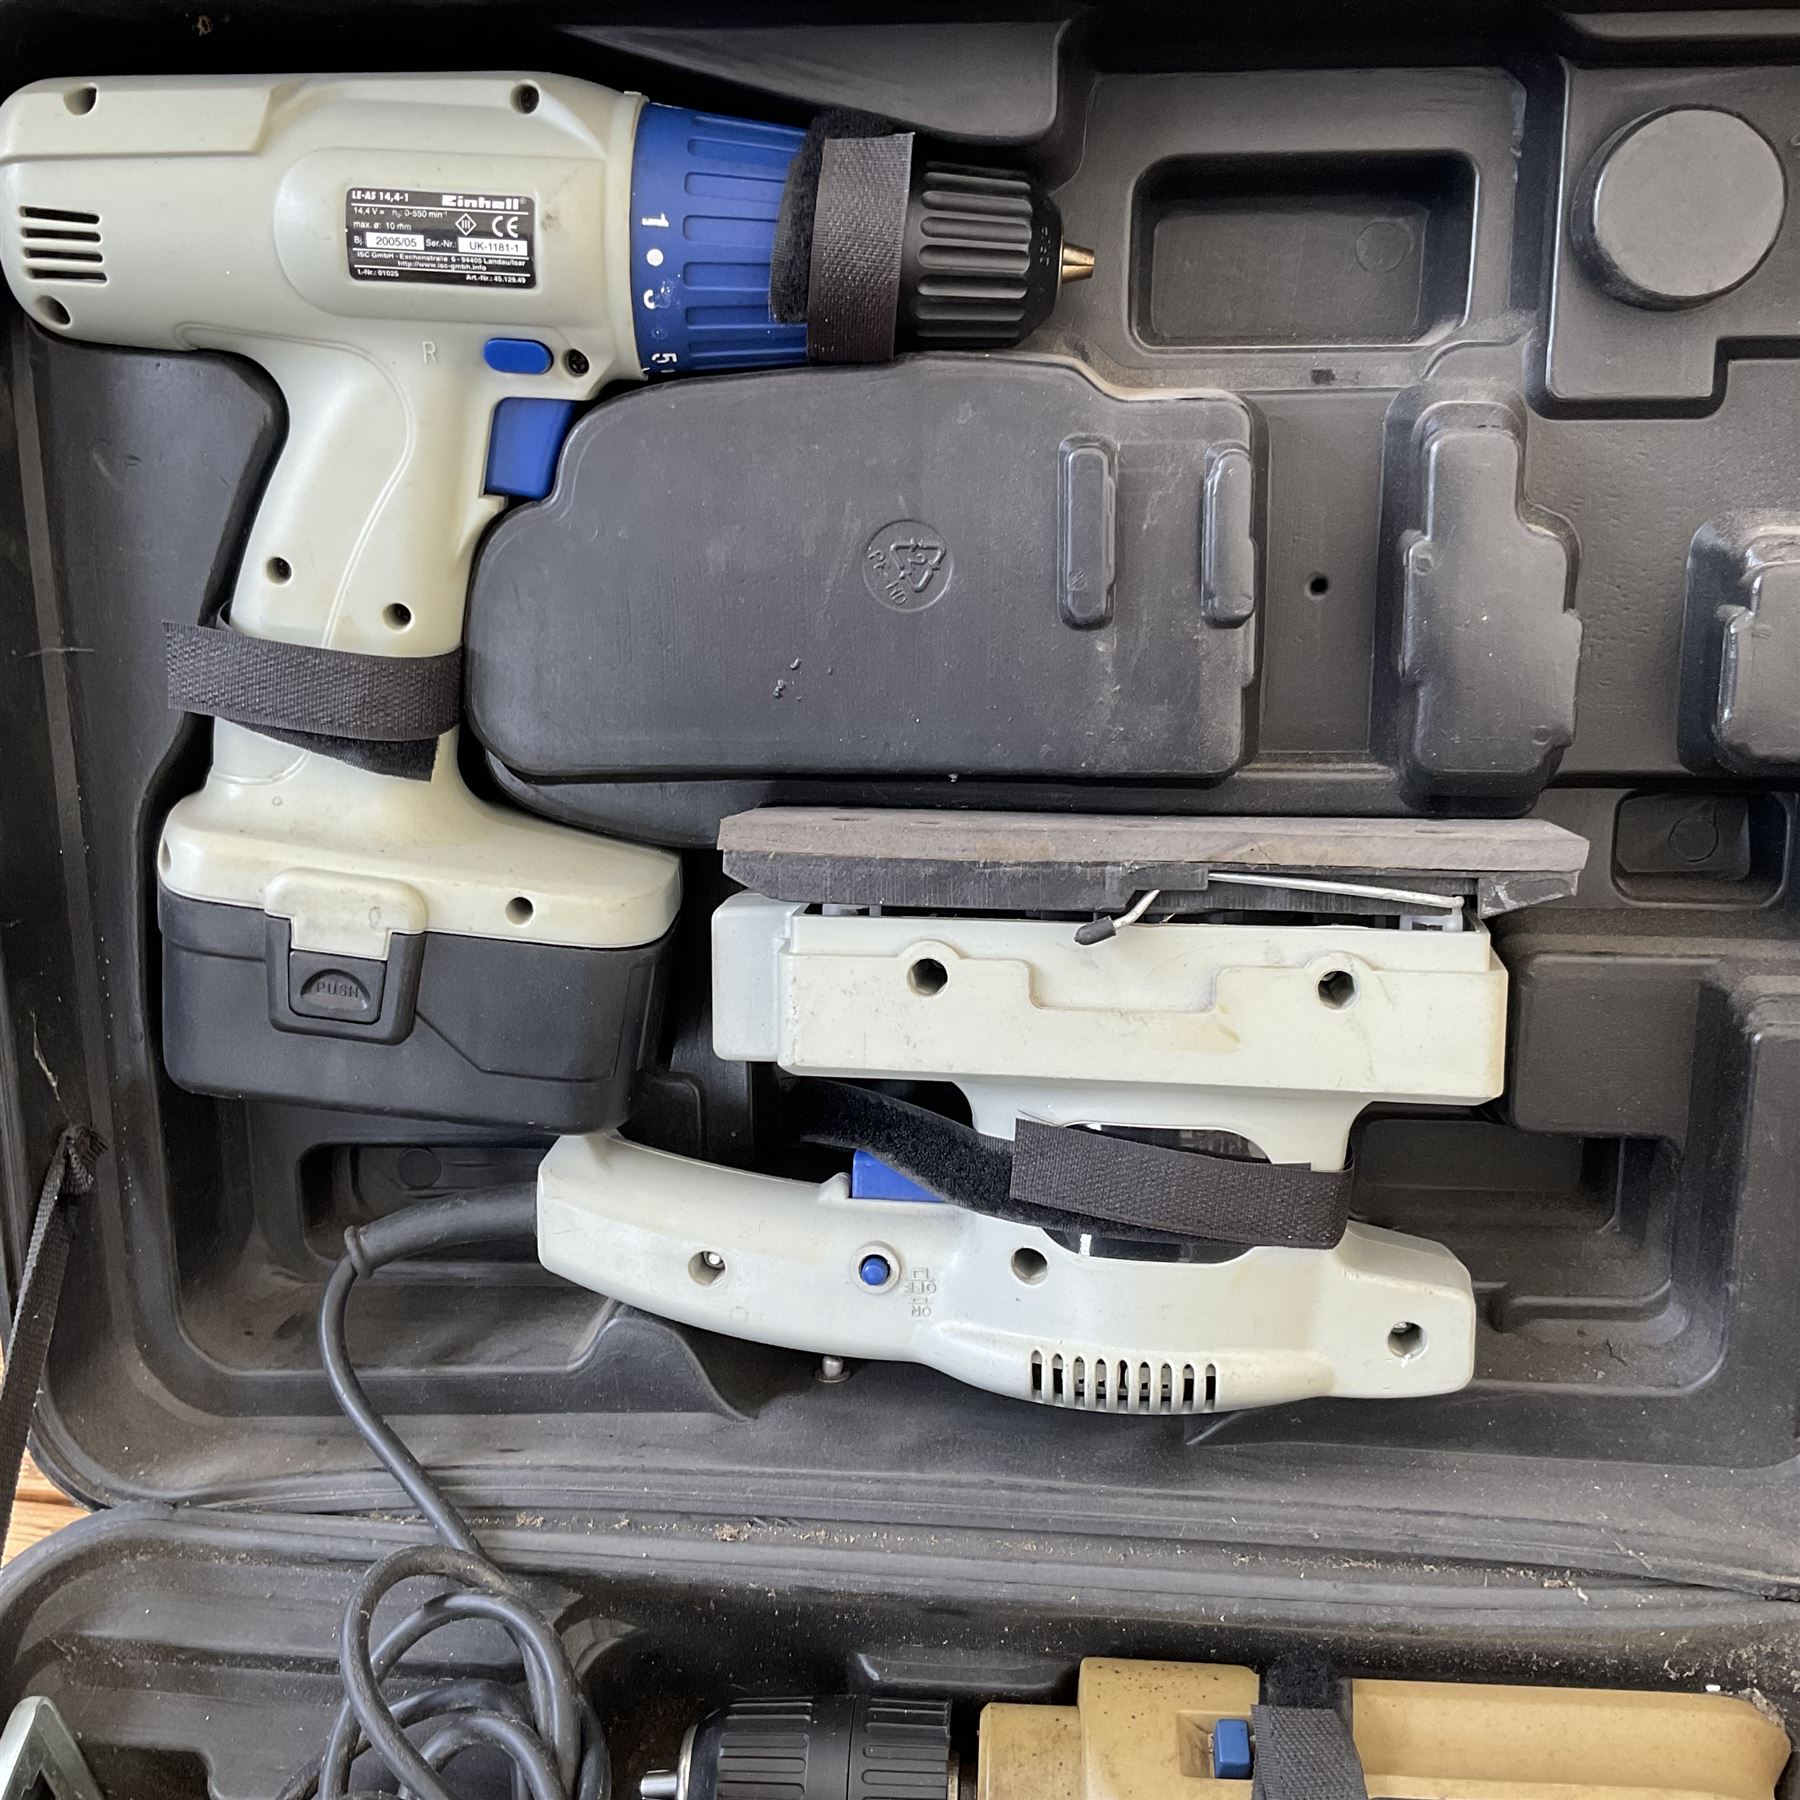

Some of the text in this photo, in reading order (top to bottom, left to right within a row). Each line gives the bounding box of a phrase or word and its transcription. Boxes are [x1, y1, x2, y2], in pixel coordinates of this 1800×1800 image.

[352, 190, 409, 202] LE-AS 14,4-1
[354, 207, 370, 215] 14,4
[372, 207, 378, 215] V
[404, 210, 427, 218] 0-550
[353, 221, 372, 229] max.
[385, 222, 396, 231] 10
[397, 223, 412, 231] mm
[641, 213, 670, 228] 1
[375, 236, 417, 248] 2005/05
[469, 241, 519, 252] UK-1181-1
[371, 251, 394, 260] GmbH
[422, 340, 437, 364] R
[651, 352, 678, 364] 5
[316, 981, 358, 998] PUSH
